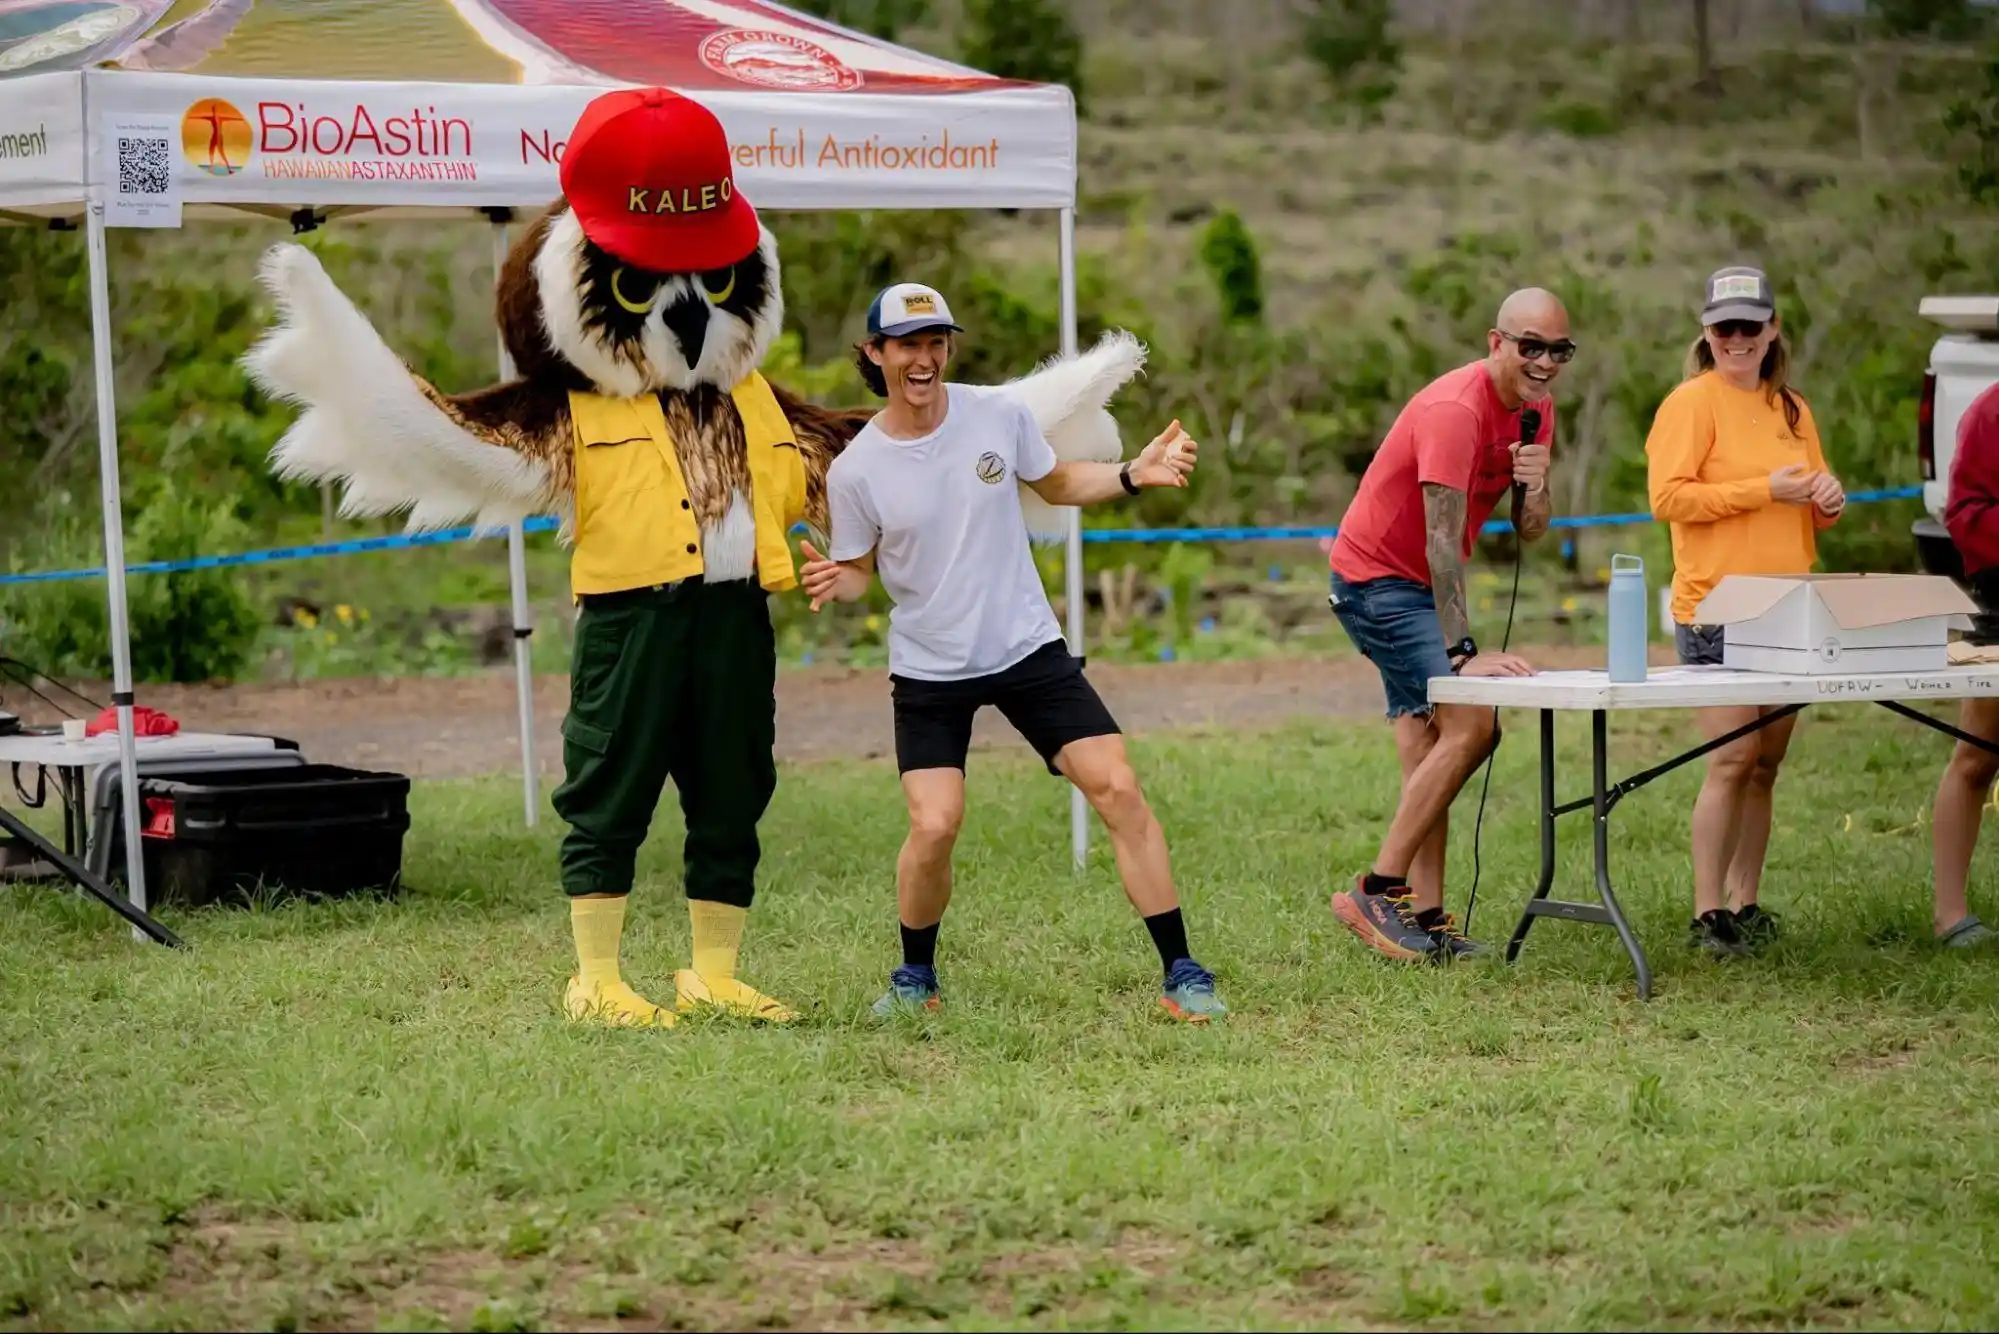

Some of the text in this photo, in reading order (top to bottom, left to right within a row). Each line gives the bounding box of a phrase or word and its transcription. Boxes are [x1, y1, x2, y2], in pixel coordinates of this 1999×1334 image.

[743, 31, 827, 60] GROWN
[0, 123, 47, 158] ment
[258, 102, 471, 156] BioAstin
[817, 128, 999, 169] Antioxidant
[628, 176, 731, 214] KALEO
